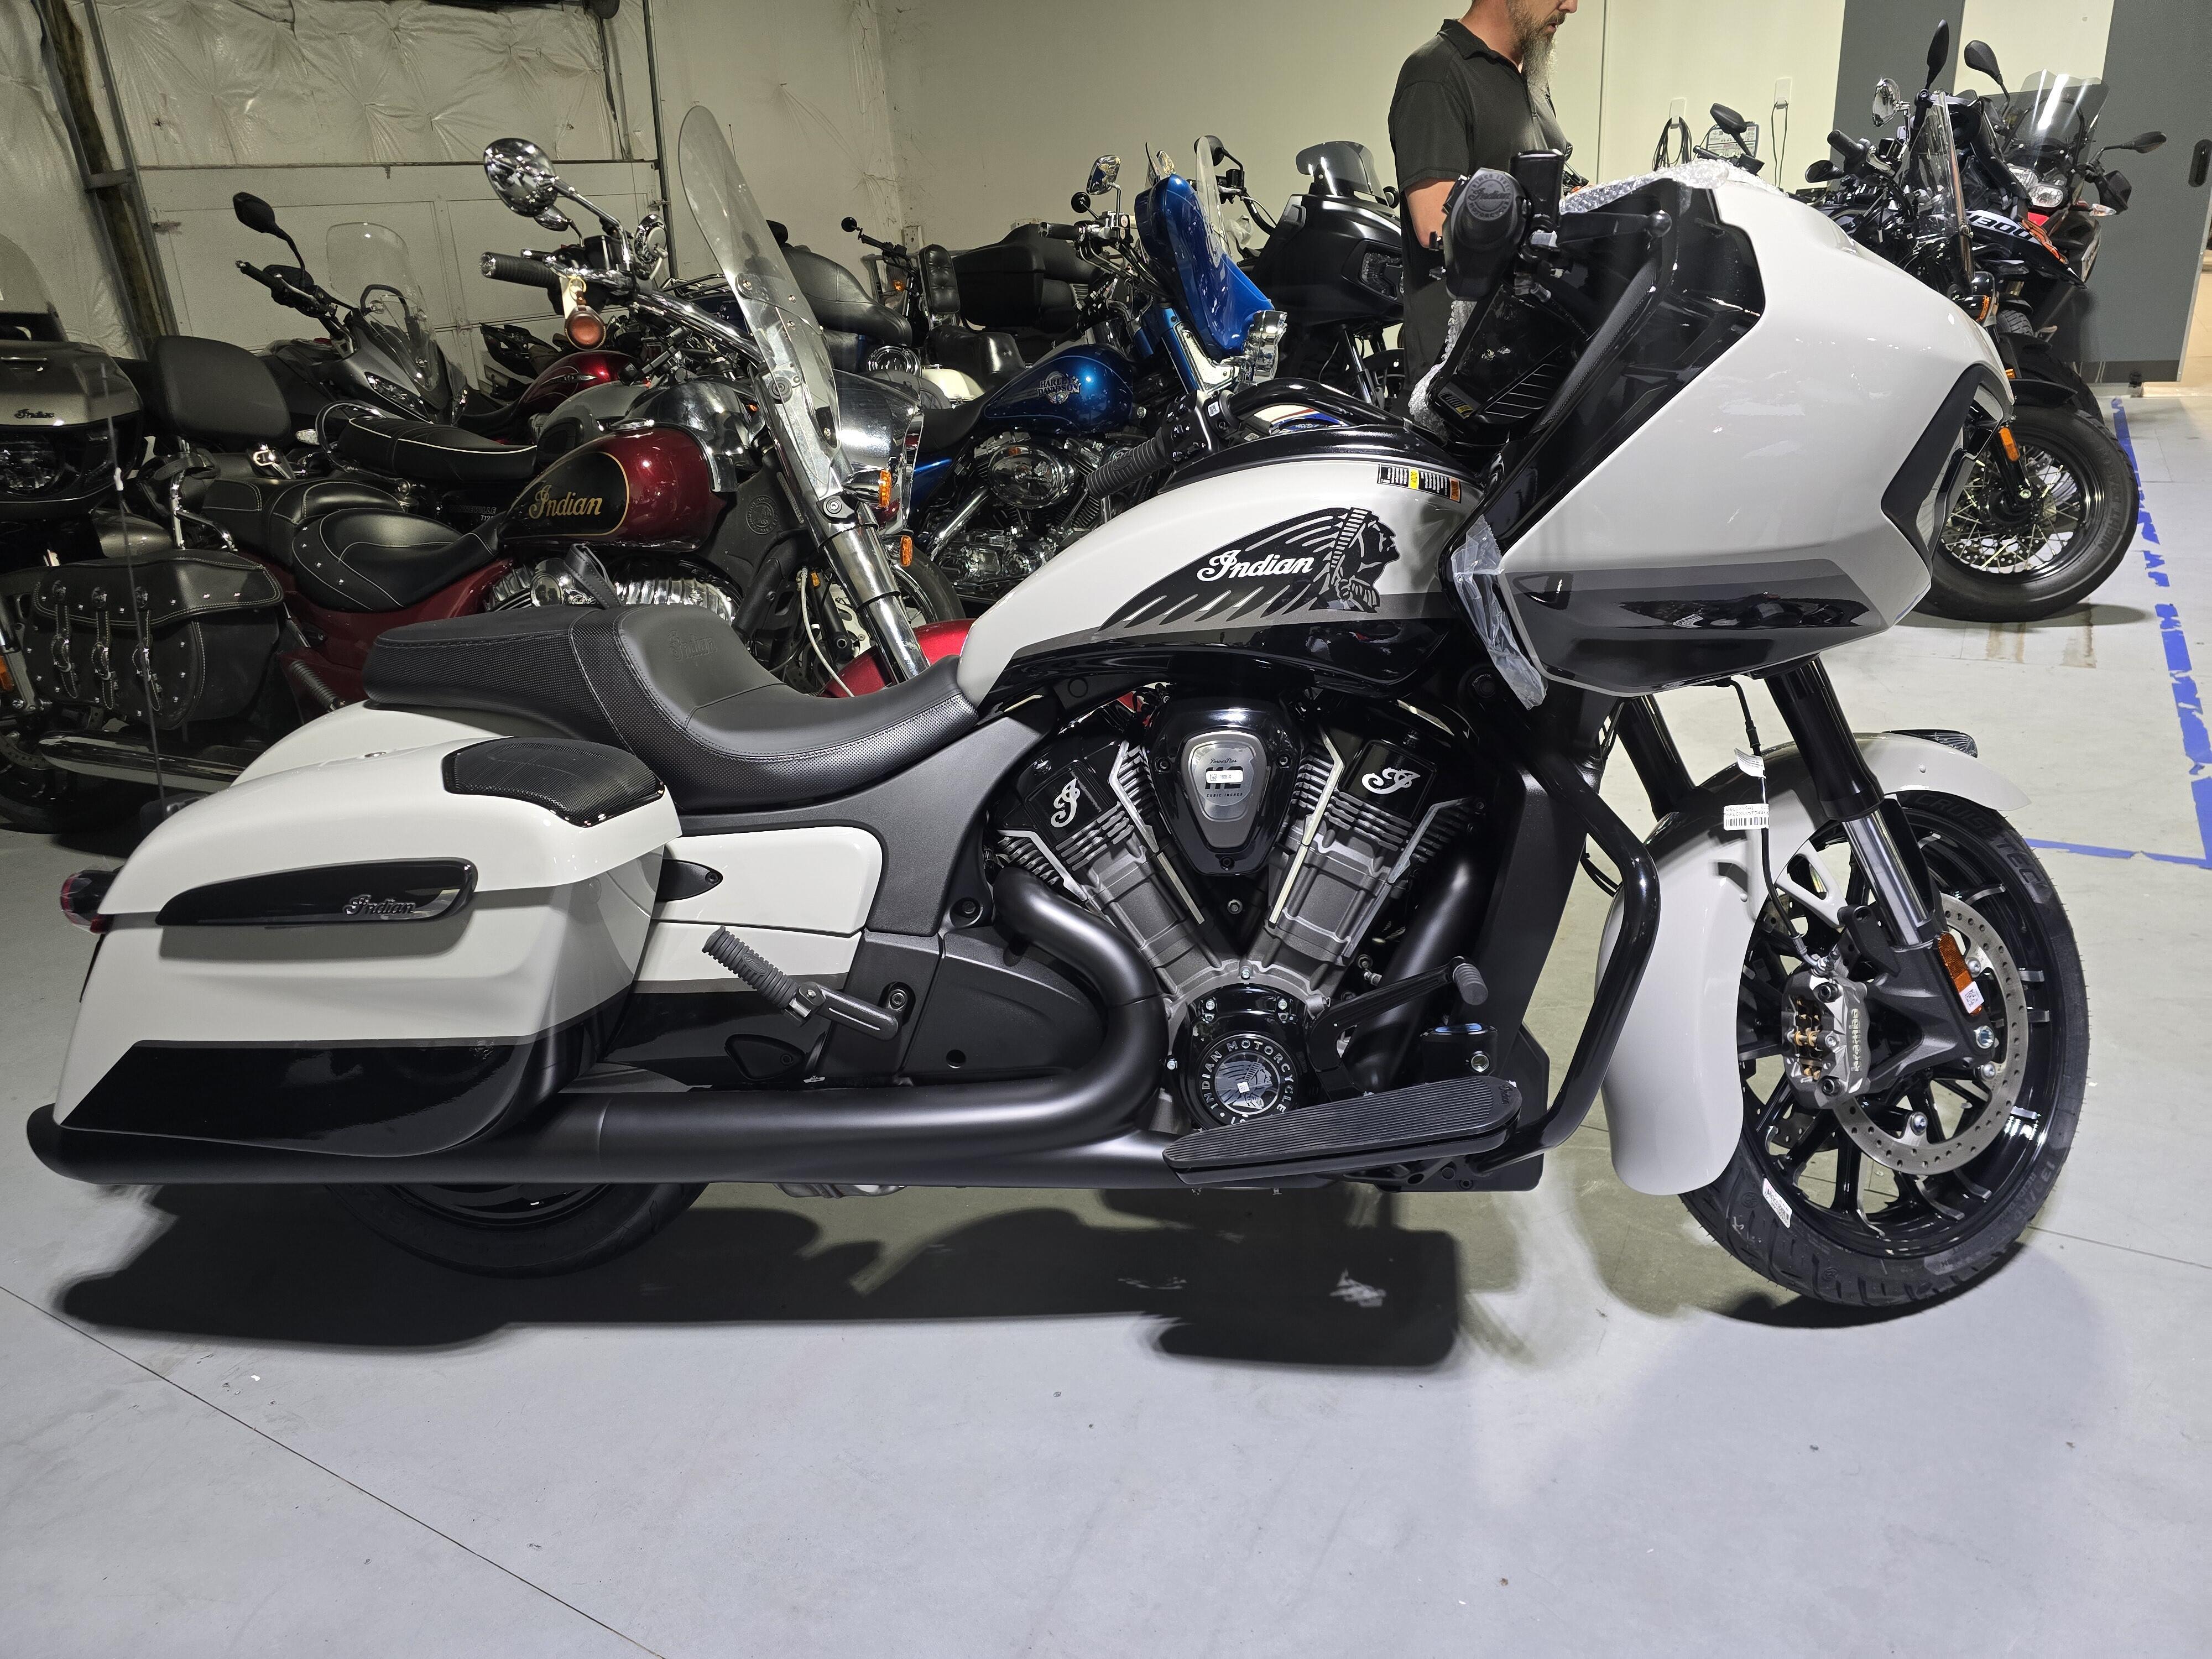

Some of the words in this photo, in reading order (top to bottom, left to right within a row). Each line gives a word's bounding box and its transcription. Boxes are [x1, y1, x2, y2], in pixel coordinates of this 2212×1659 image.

[1468, 187, 1511, 201] Indian
[1040, 378, 1072, 388] HARLEY
[529, 484, 603, 519] Indian
[1197, 549, 1314, 582] Indian
[667, 630, 717, 661] Indian
[343, 894, 416, 915] Indian
[1849, 1008, 1862, 1072] brembo
[1202, 1050, 1222, 1110] INDIAN
[1226, 1040, 1294, 1113] MOTORCYCLE
